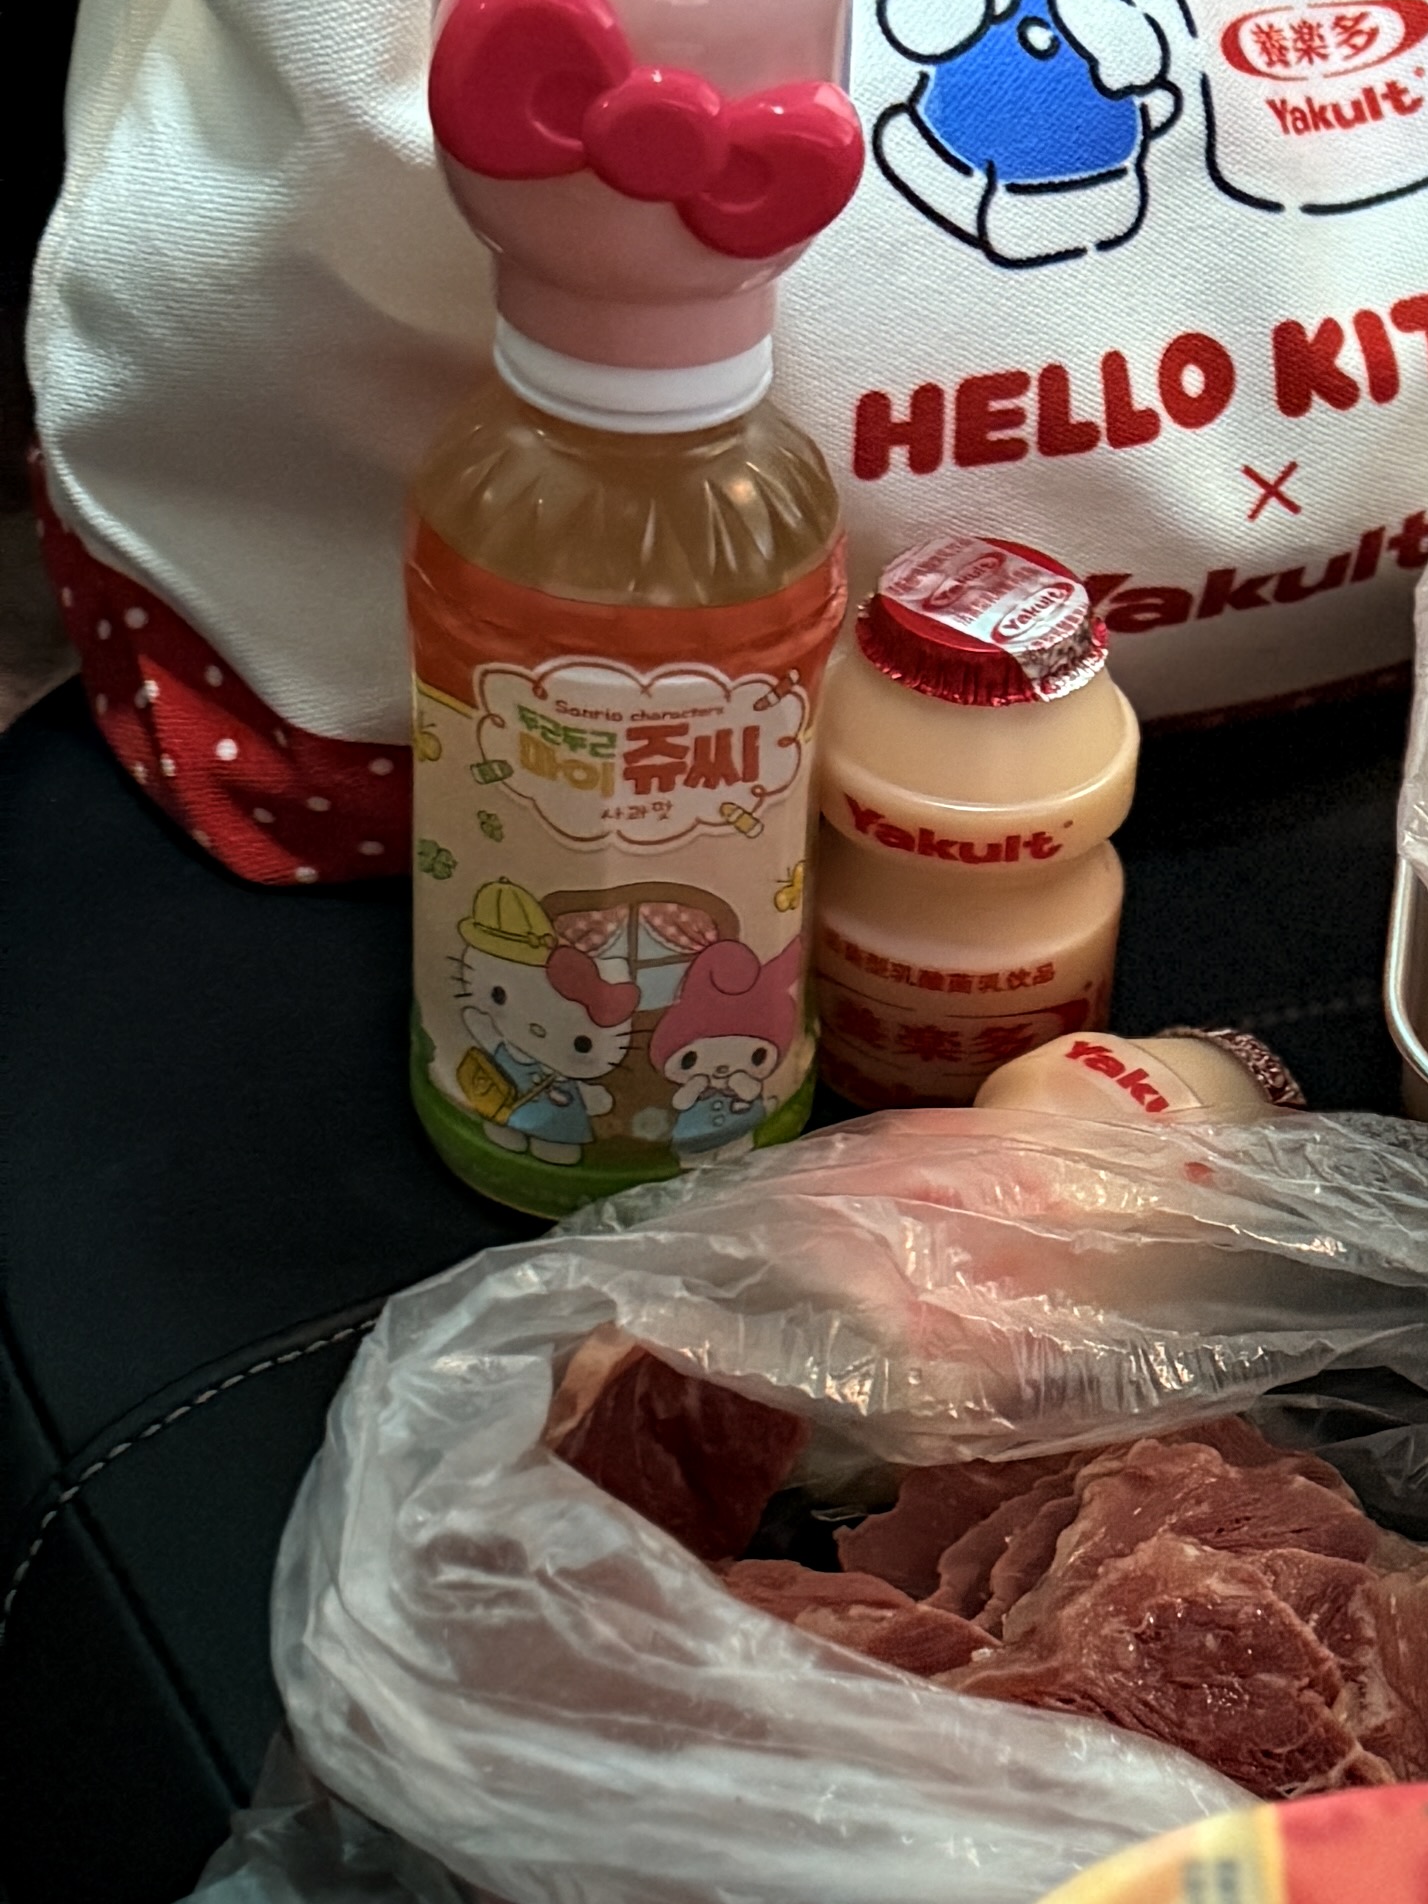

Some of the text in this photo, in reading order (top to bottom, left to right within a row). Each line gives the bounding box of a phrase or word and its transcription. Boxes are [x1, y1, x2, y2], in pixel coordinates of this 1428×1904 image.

[1266, 80, 1425, 136] Yakult
[850, 330, 1237, 482] HELLO
[1003, 587, 1069, 632] Yakult
[555, 700, 623, 722] Sanrio
[623, 722, 760, 795] 쥬씨
[843, 792, 1063, 864] Yakult
